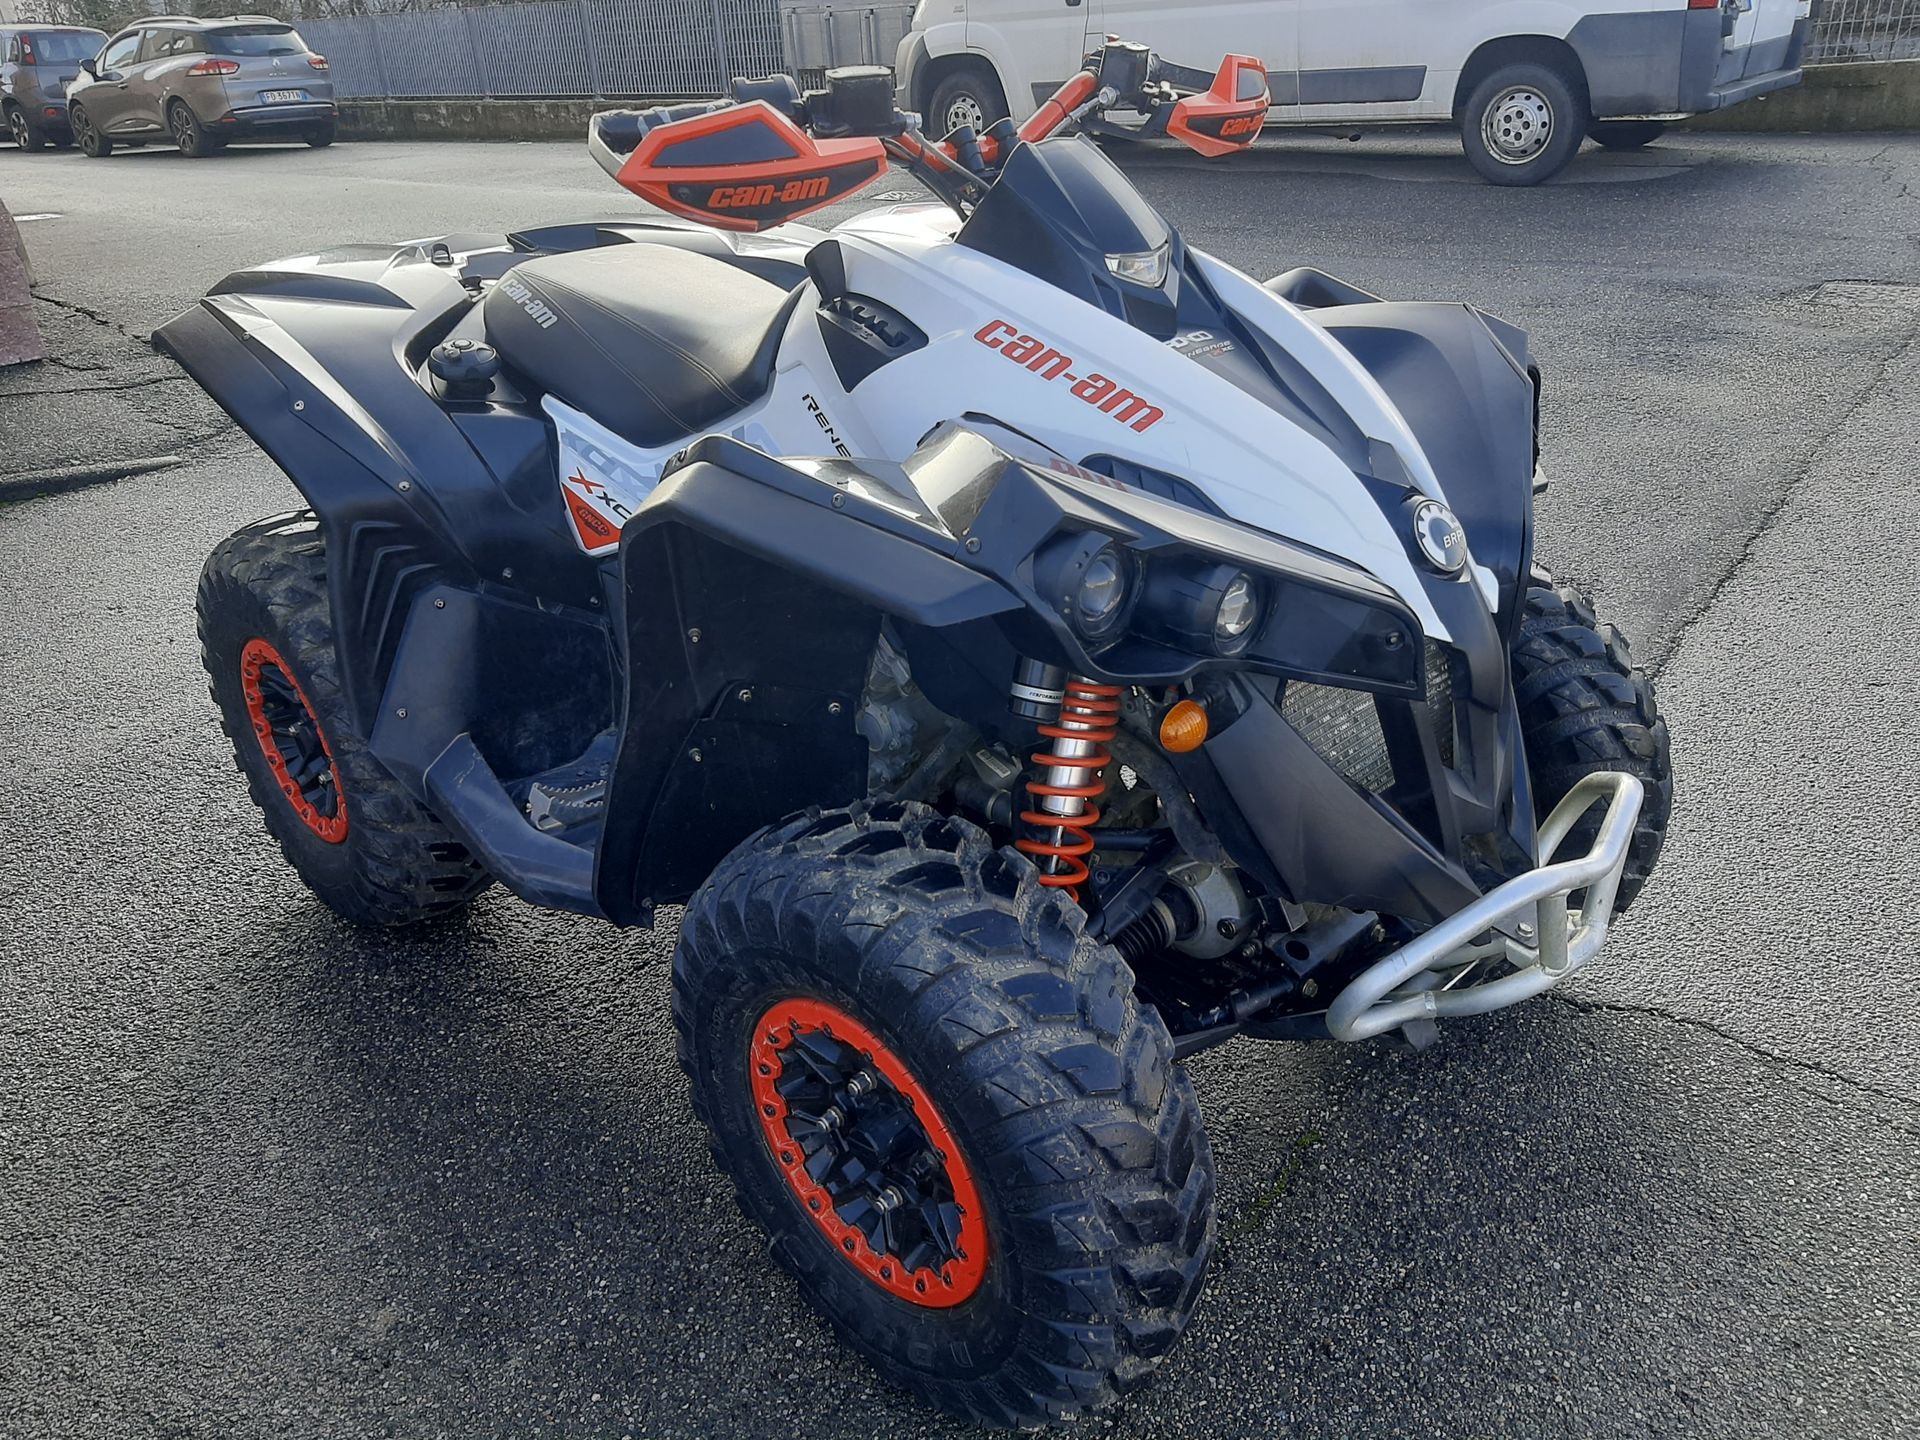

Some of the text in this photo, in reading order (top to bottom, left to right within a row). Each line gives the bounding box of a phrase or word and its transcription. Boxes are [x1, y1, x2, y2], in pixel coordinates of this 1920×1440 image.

[707, 176, 830, 208] can-am
[500, 279, 558, 329] can-am
[973, 319, 1165, 433] can-am
[1443, 529, 1464, 548] BRP
